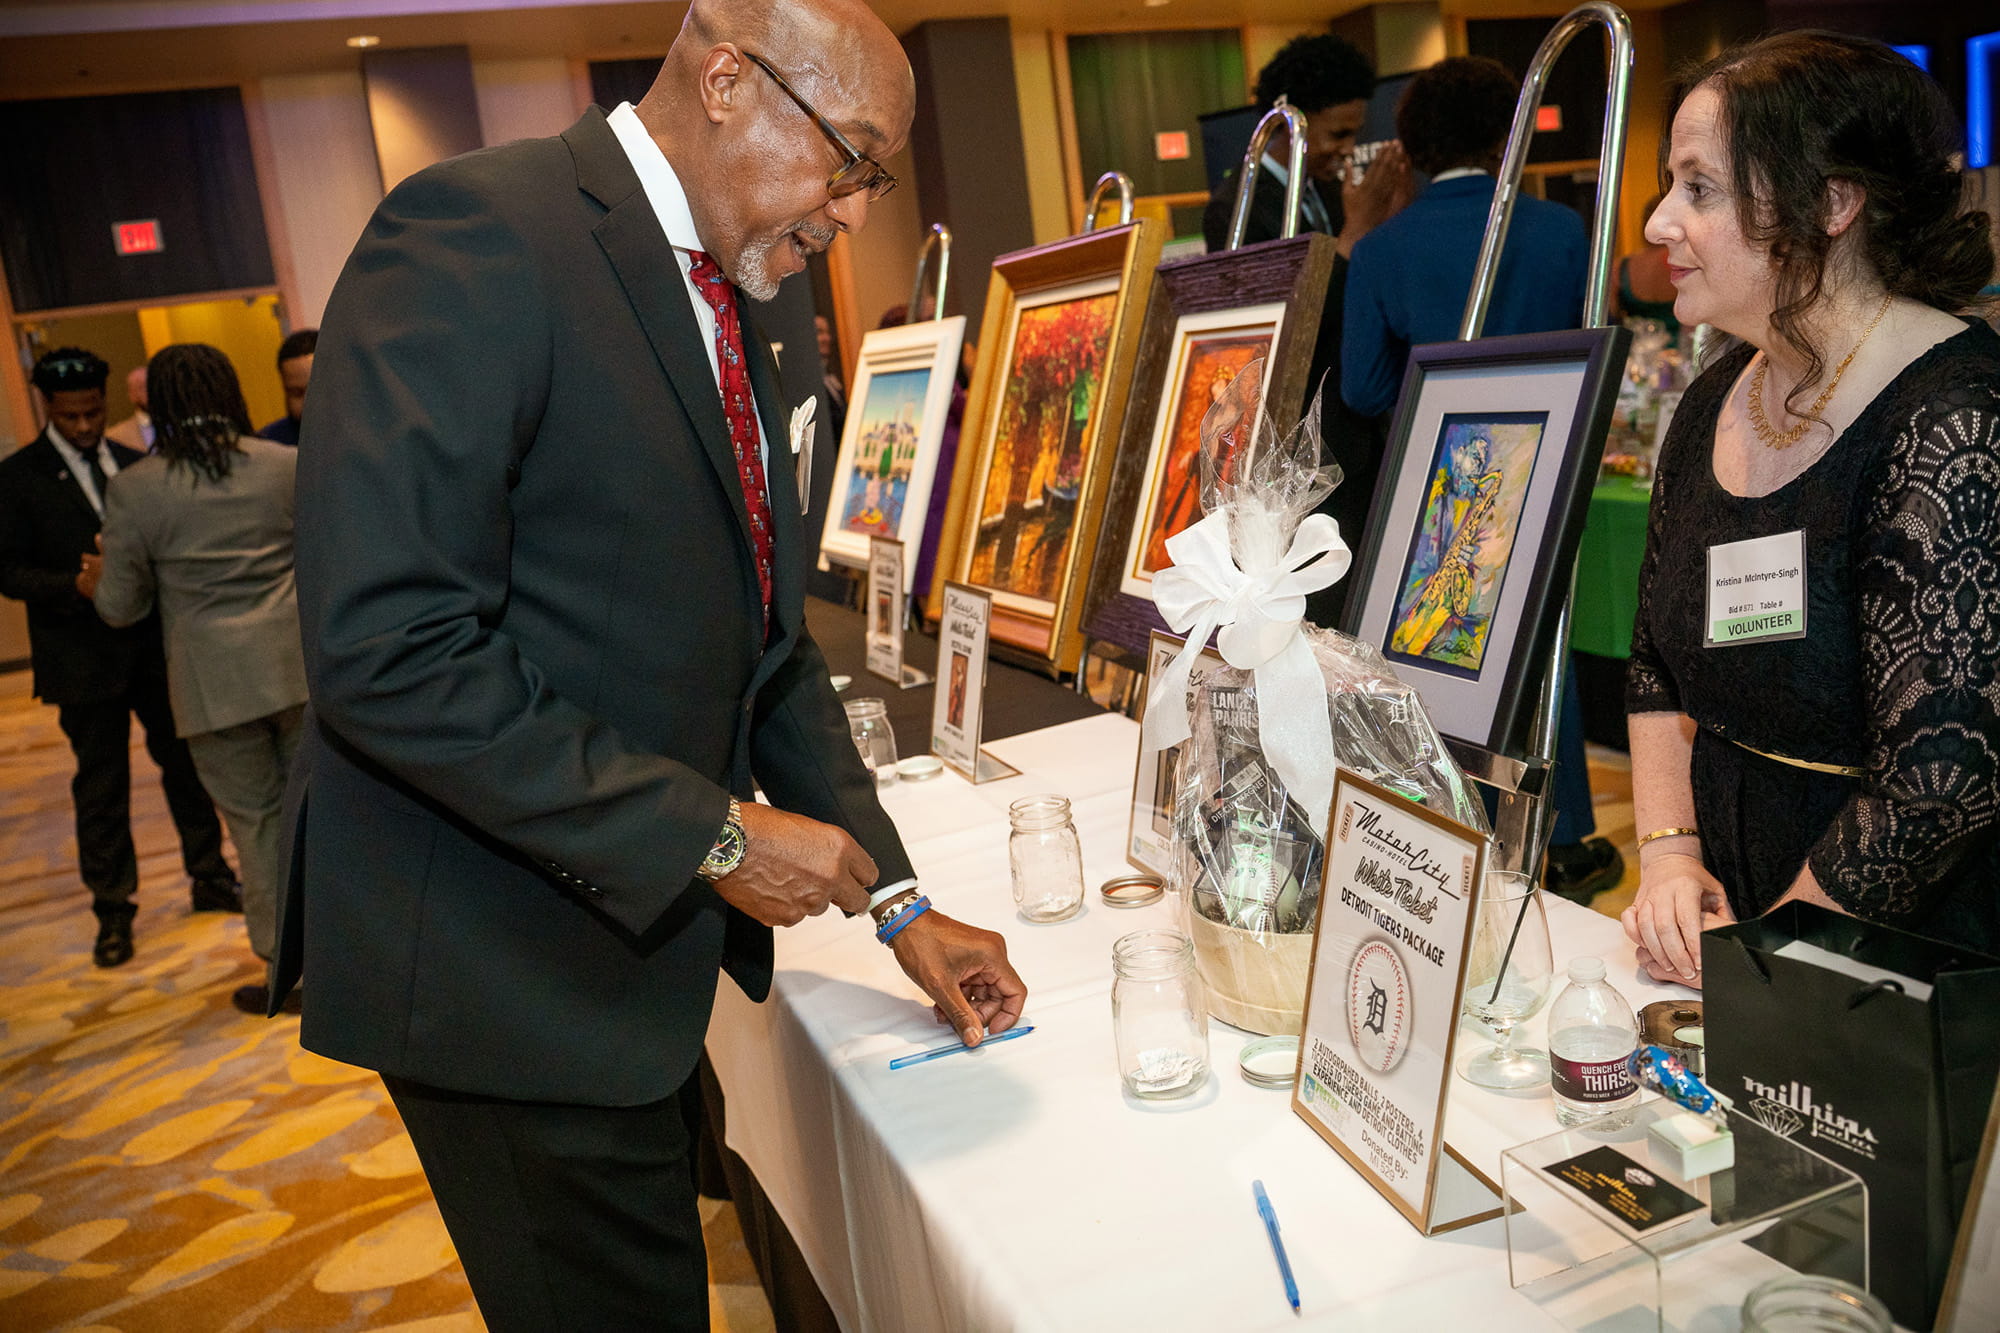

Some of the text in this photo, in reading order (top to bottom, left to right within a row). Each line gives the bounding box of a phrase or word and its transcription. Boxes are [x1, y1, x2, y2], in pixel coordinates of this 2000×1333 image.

[1716, 567, 1799, 587] Kristina McIntyre-Singh
[1729, 605, 1738, 614] Bid
[1760, 601, 1777, 610] Table
[1728, 614, 1793, 636] VOLUNTEER
[1215, 709, 1259, 729] PARRIS
[1354, 856, 1438, 924] White Ticket
[1341, 887, 1445, 967] DETROIT TIGERS PACKAGE
[1581, 1061, 1627, 1075] QUENCH EVE
[1314, 1038, 1319, 1049] 2
[1380, 1096, 1386, 1108] 2
[1418, 1129, 1423, 1141] 4
[1582, 1070, 1631, 1092] THIRS
[1311, 1048, 1334, 1075] TICKETS
[1335, 1068, 1342, 1083] TO
[1343, 1075, 1363, 1102] TIGERS
[1363, 1096, 1381, 1118] GAME
[1381, 1113, 1395, 1132] AND
[1395, 1122, 1424, 1156] BATTING
[1313, 1064, 1348, 1103] EXPERIENCE
[1348, 1098, 1361, 1115] AND
[1362, 1108, 1386, 1139] DETROIT
[1387, 1131, 1418, 1165] CLOTHES
[1361, 1130, 1409, 1180] Donated By:
[1370, 1152, 1380, 1169] MI
